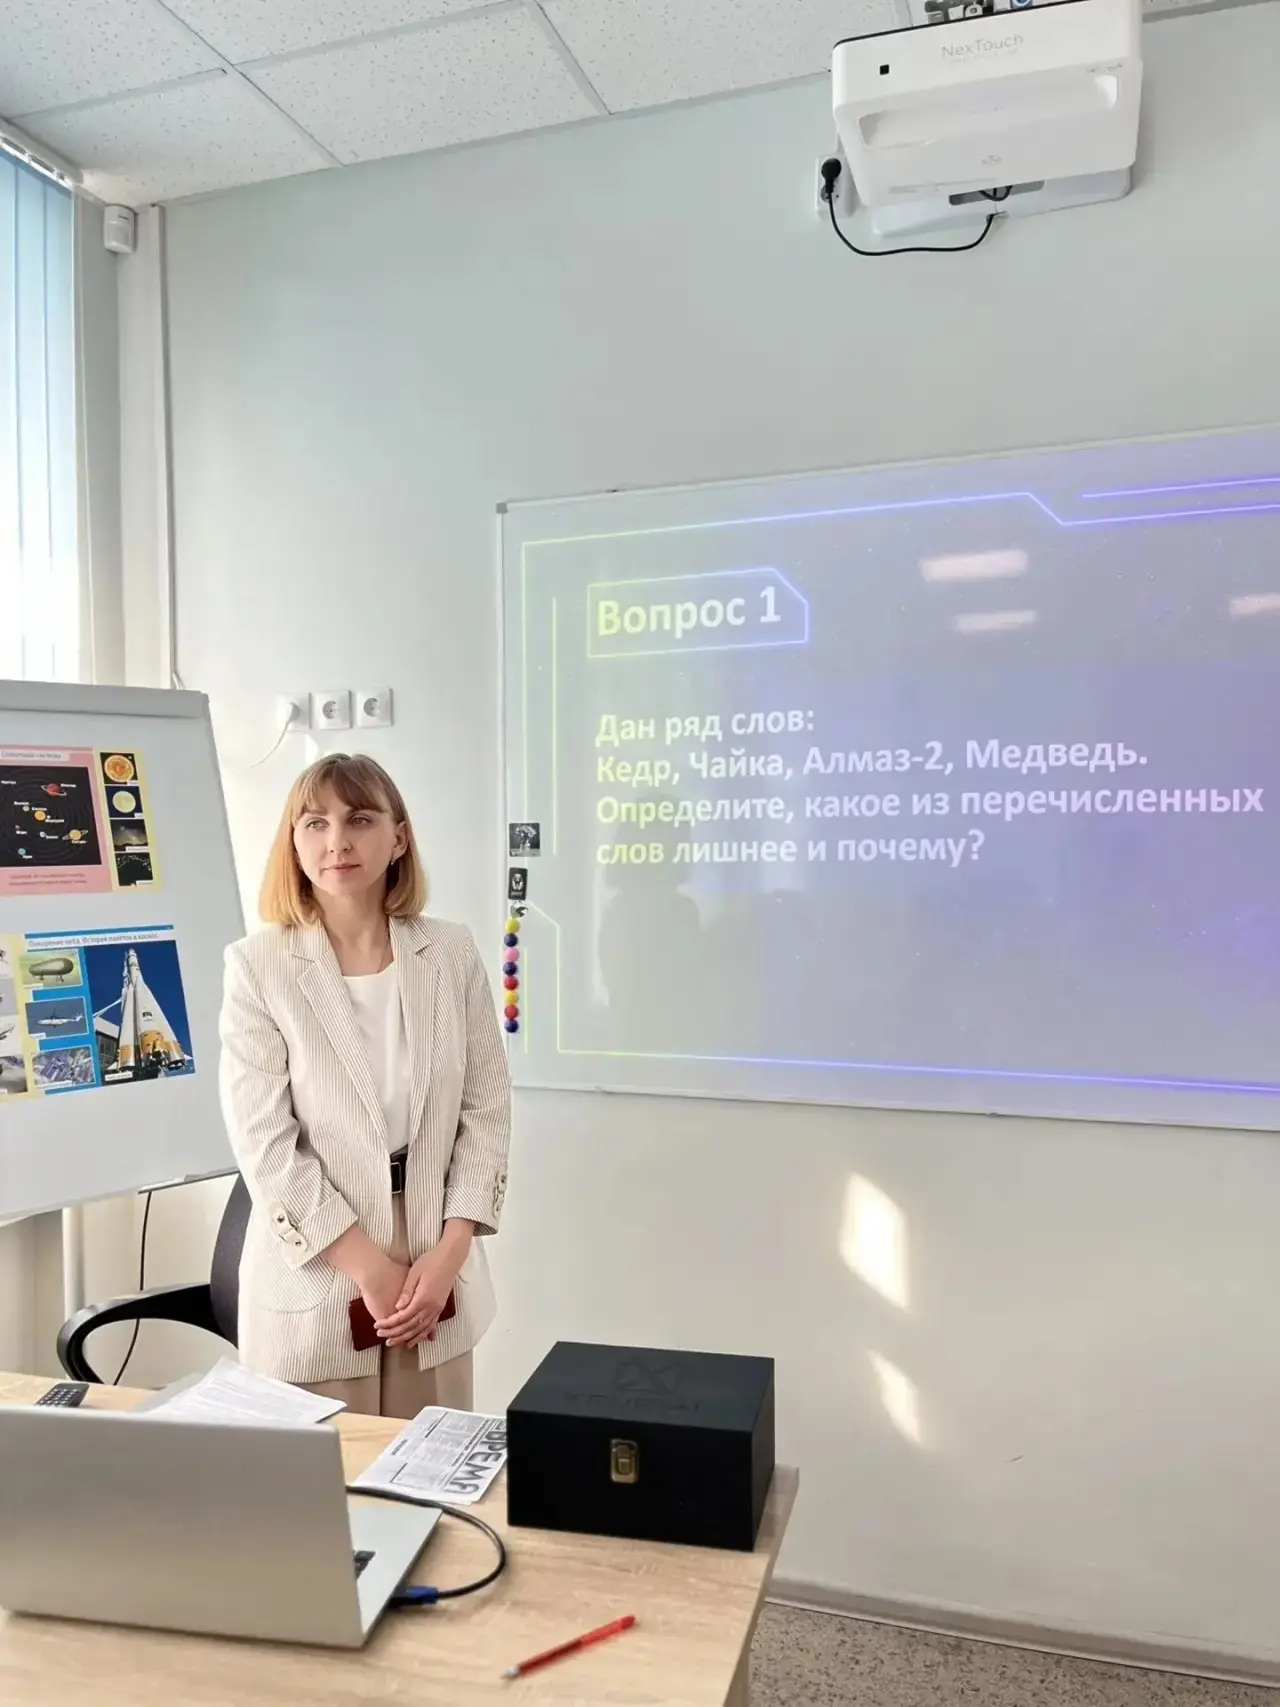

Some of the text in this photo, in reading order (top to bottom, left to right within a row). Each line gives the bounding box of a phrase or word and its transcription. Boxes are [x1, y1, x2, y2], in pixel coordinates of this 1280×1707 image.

[942, 33, 1024, 60] NexTouch
[598, 586, 781, 639] Вопрос 1
[595, 709, 814, 747] Дан ряд слов:
[597, 739, 1148, 788] Кедр, Чайка, Алмаз-2, Медведь.
[597, 788, 1264, 829] Определите, какое из перечисленных
[596, 829, 985, 868] слов лишнее и почему?
